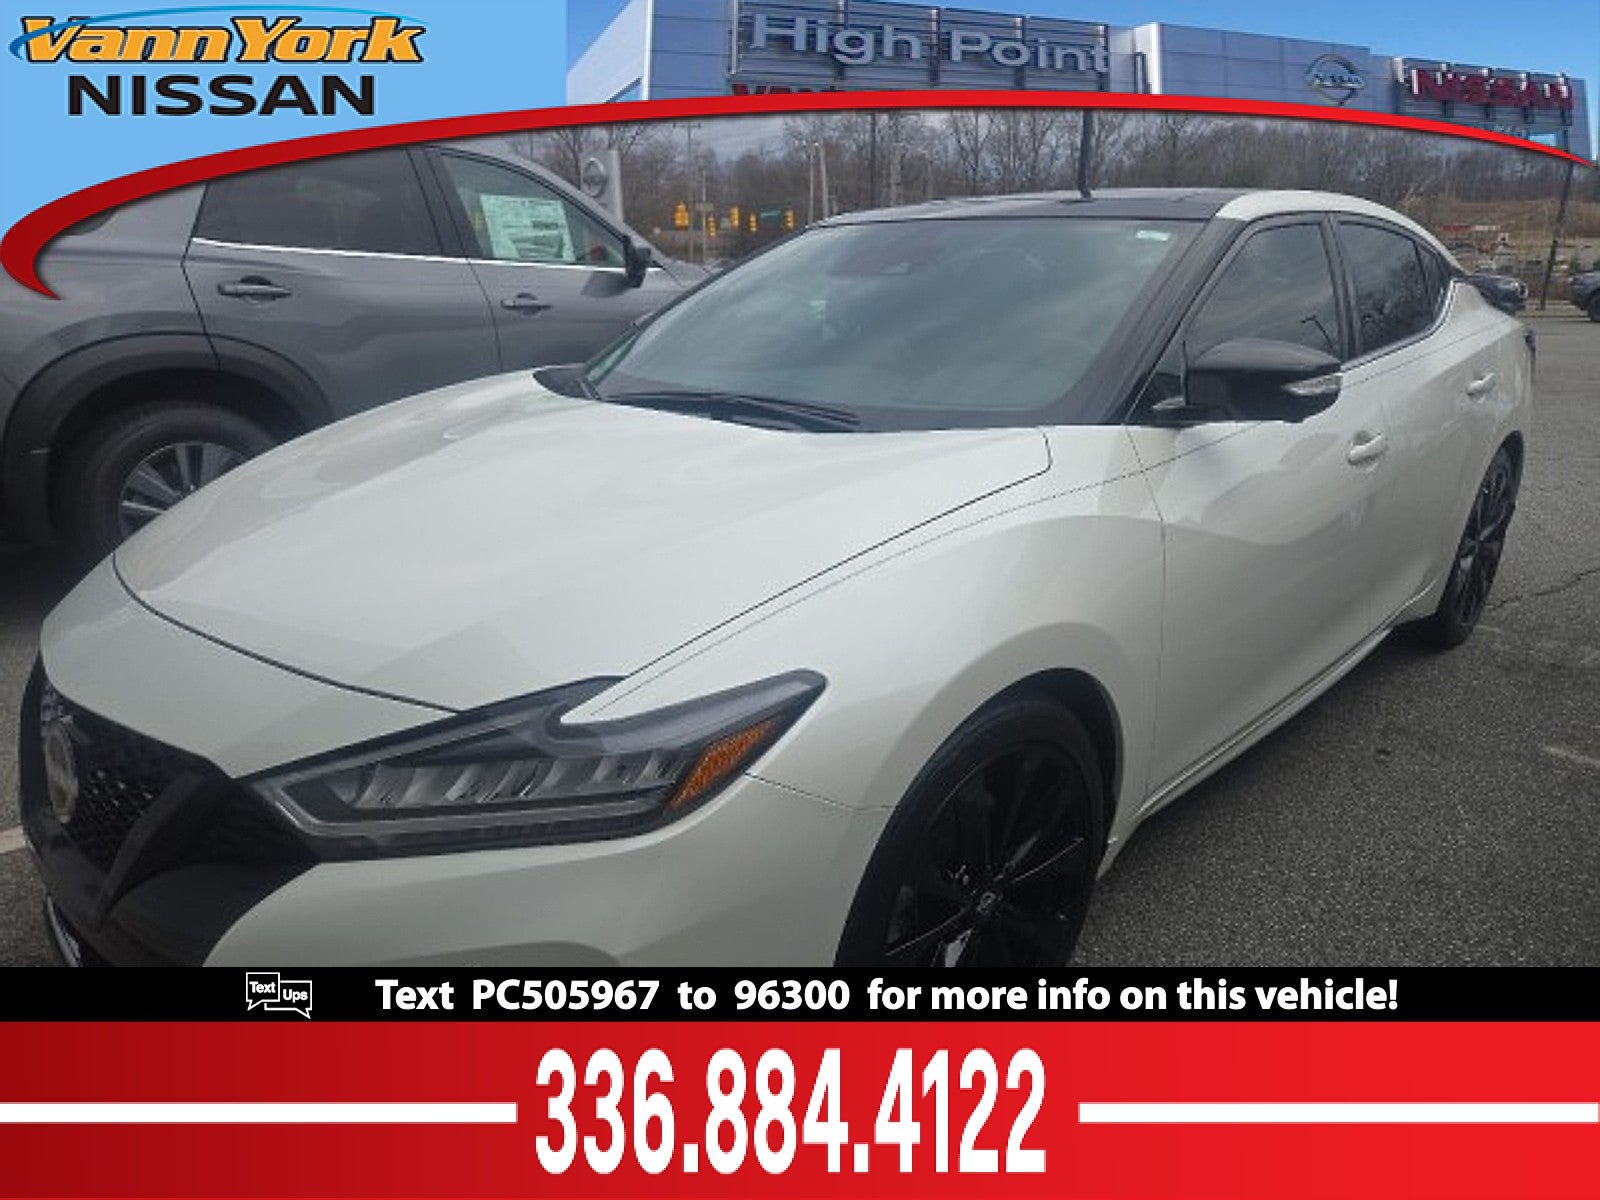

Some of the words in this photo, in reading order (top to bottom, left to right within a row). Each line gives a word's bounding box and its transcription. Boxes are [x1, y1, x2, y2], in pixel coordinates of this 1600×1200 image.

[751, 13, 921, 65] High
[951, 29, 1109, 73] Point
[1411, 68, 1573, 110] NISSAN
